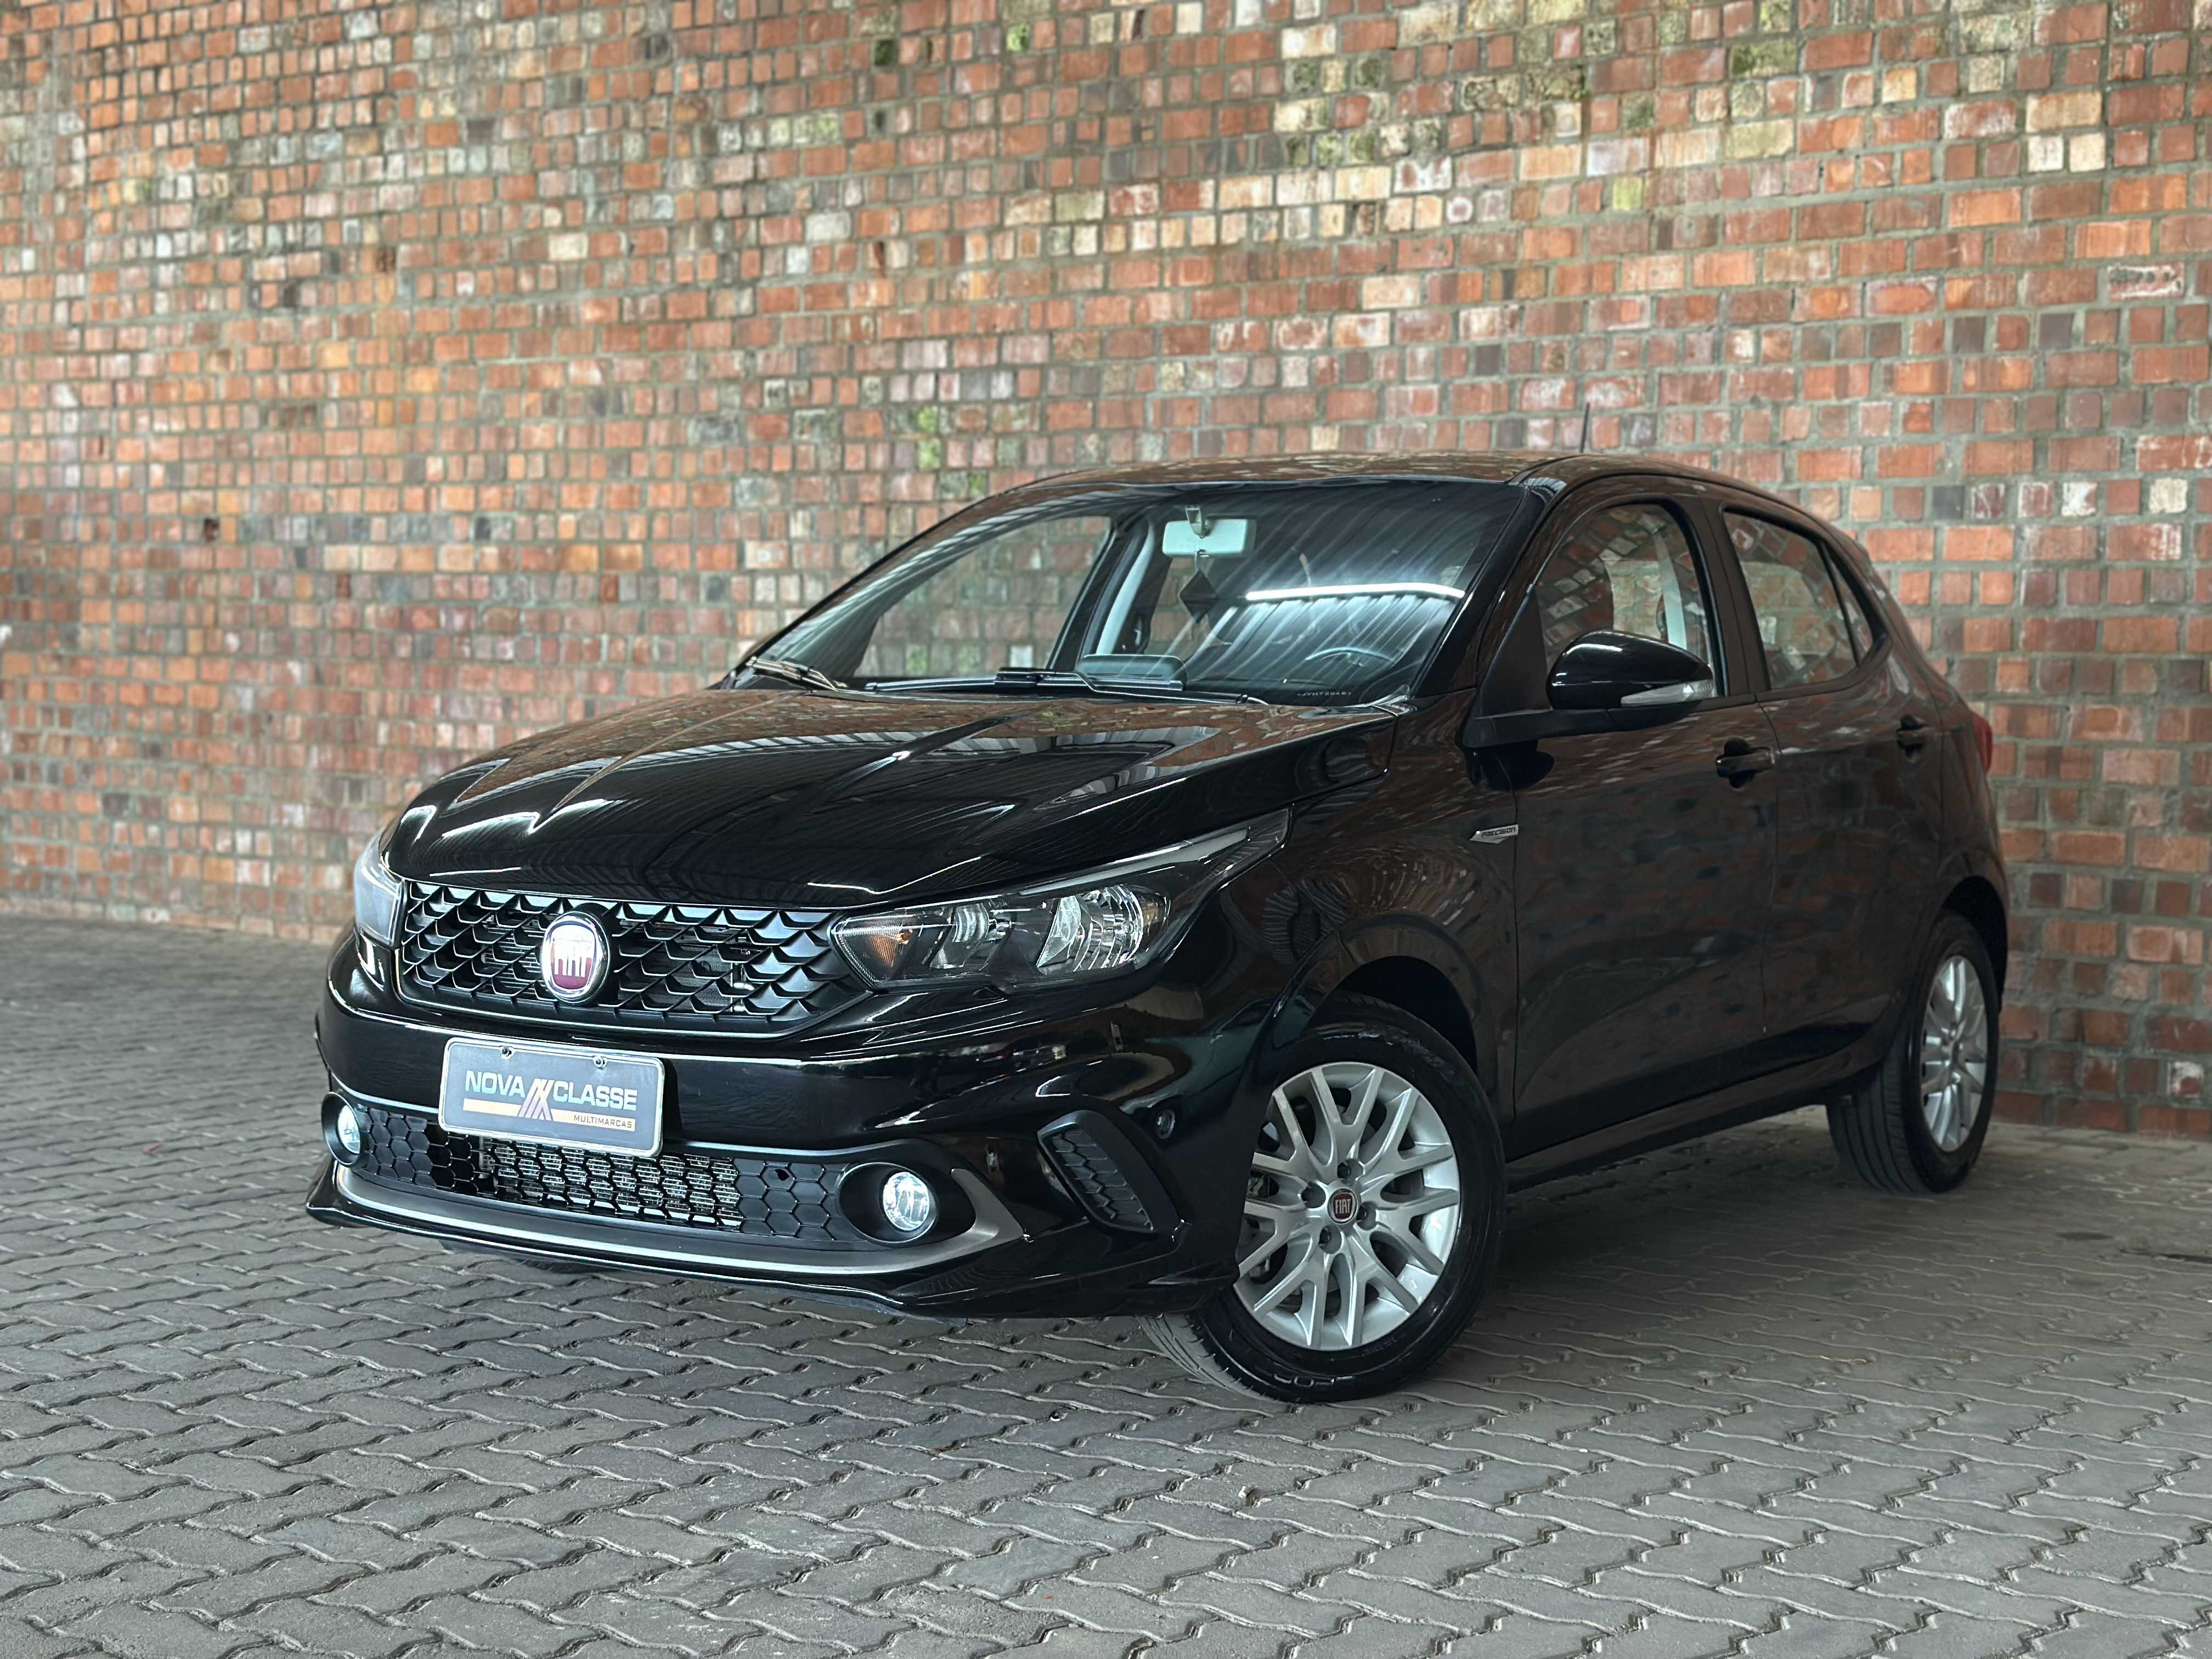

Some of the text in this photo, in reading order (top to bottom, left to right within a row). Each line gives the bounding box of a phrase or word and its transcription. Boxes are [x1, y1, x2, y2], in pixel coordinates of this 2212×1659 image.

[465, 1070, 637, 1111] NOVA CLASSE
[573, 1114, 633, 1129] MULTIMARCAS
[1334, 1198, 1351, 1214] FIAT
